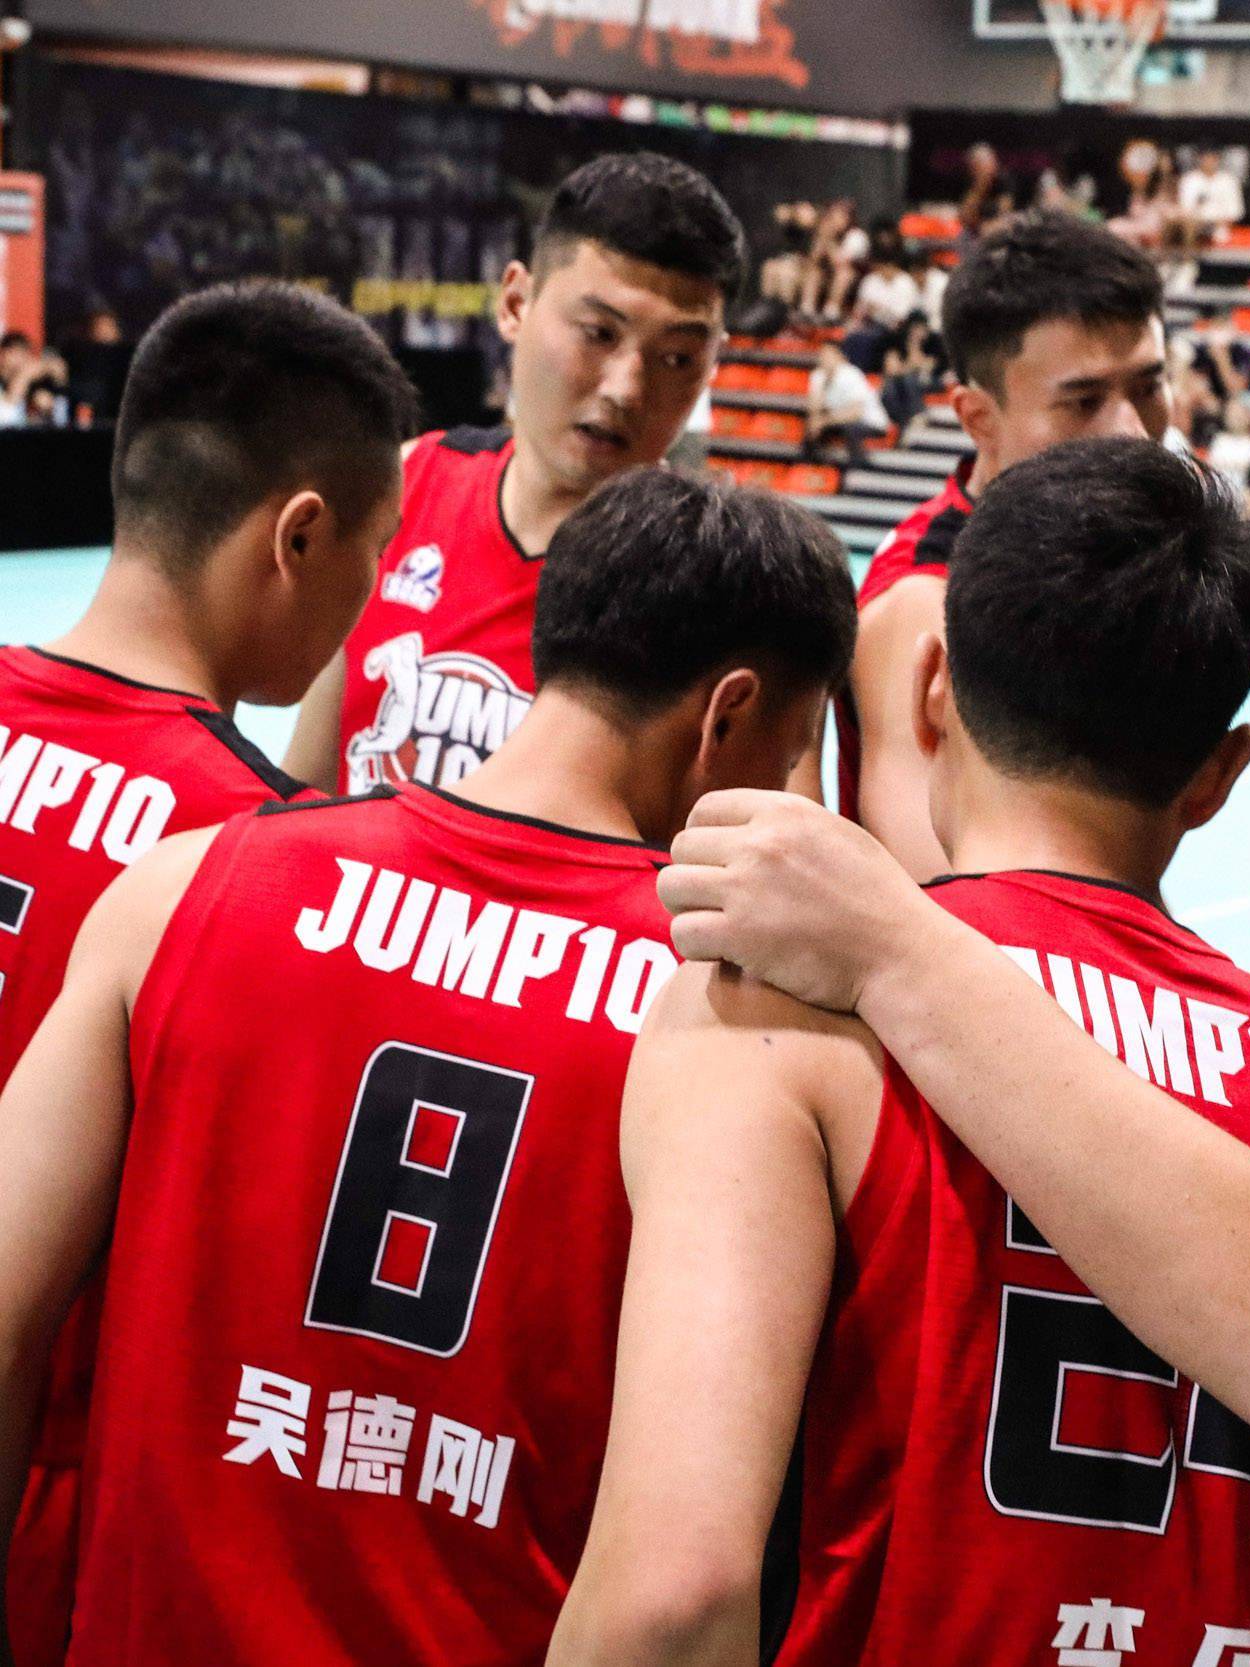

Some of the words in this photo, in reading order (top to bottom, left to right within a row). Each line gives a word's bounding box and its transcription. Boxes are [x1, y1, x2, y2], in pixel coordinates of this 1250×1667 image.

[294, 857, 680, 1035] JUMP10
[304, 1041, 535, 1358] 8
[223, 1364, 515, 1528] 吴德刚
